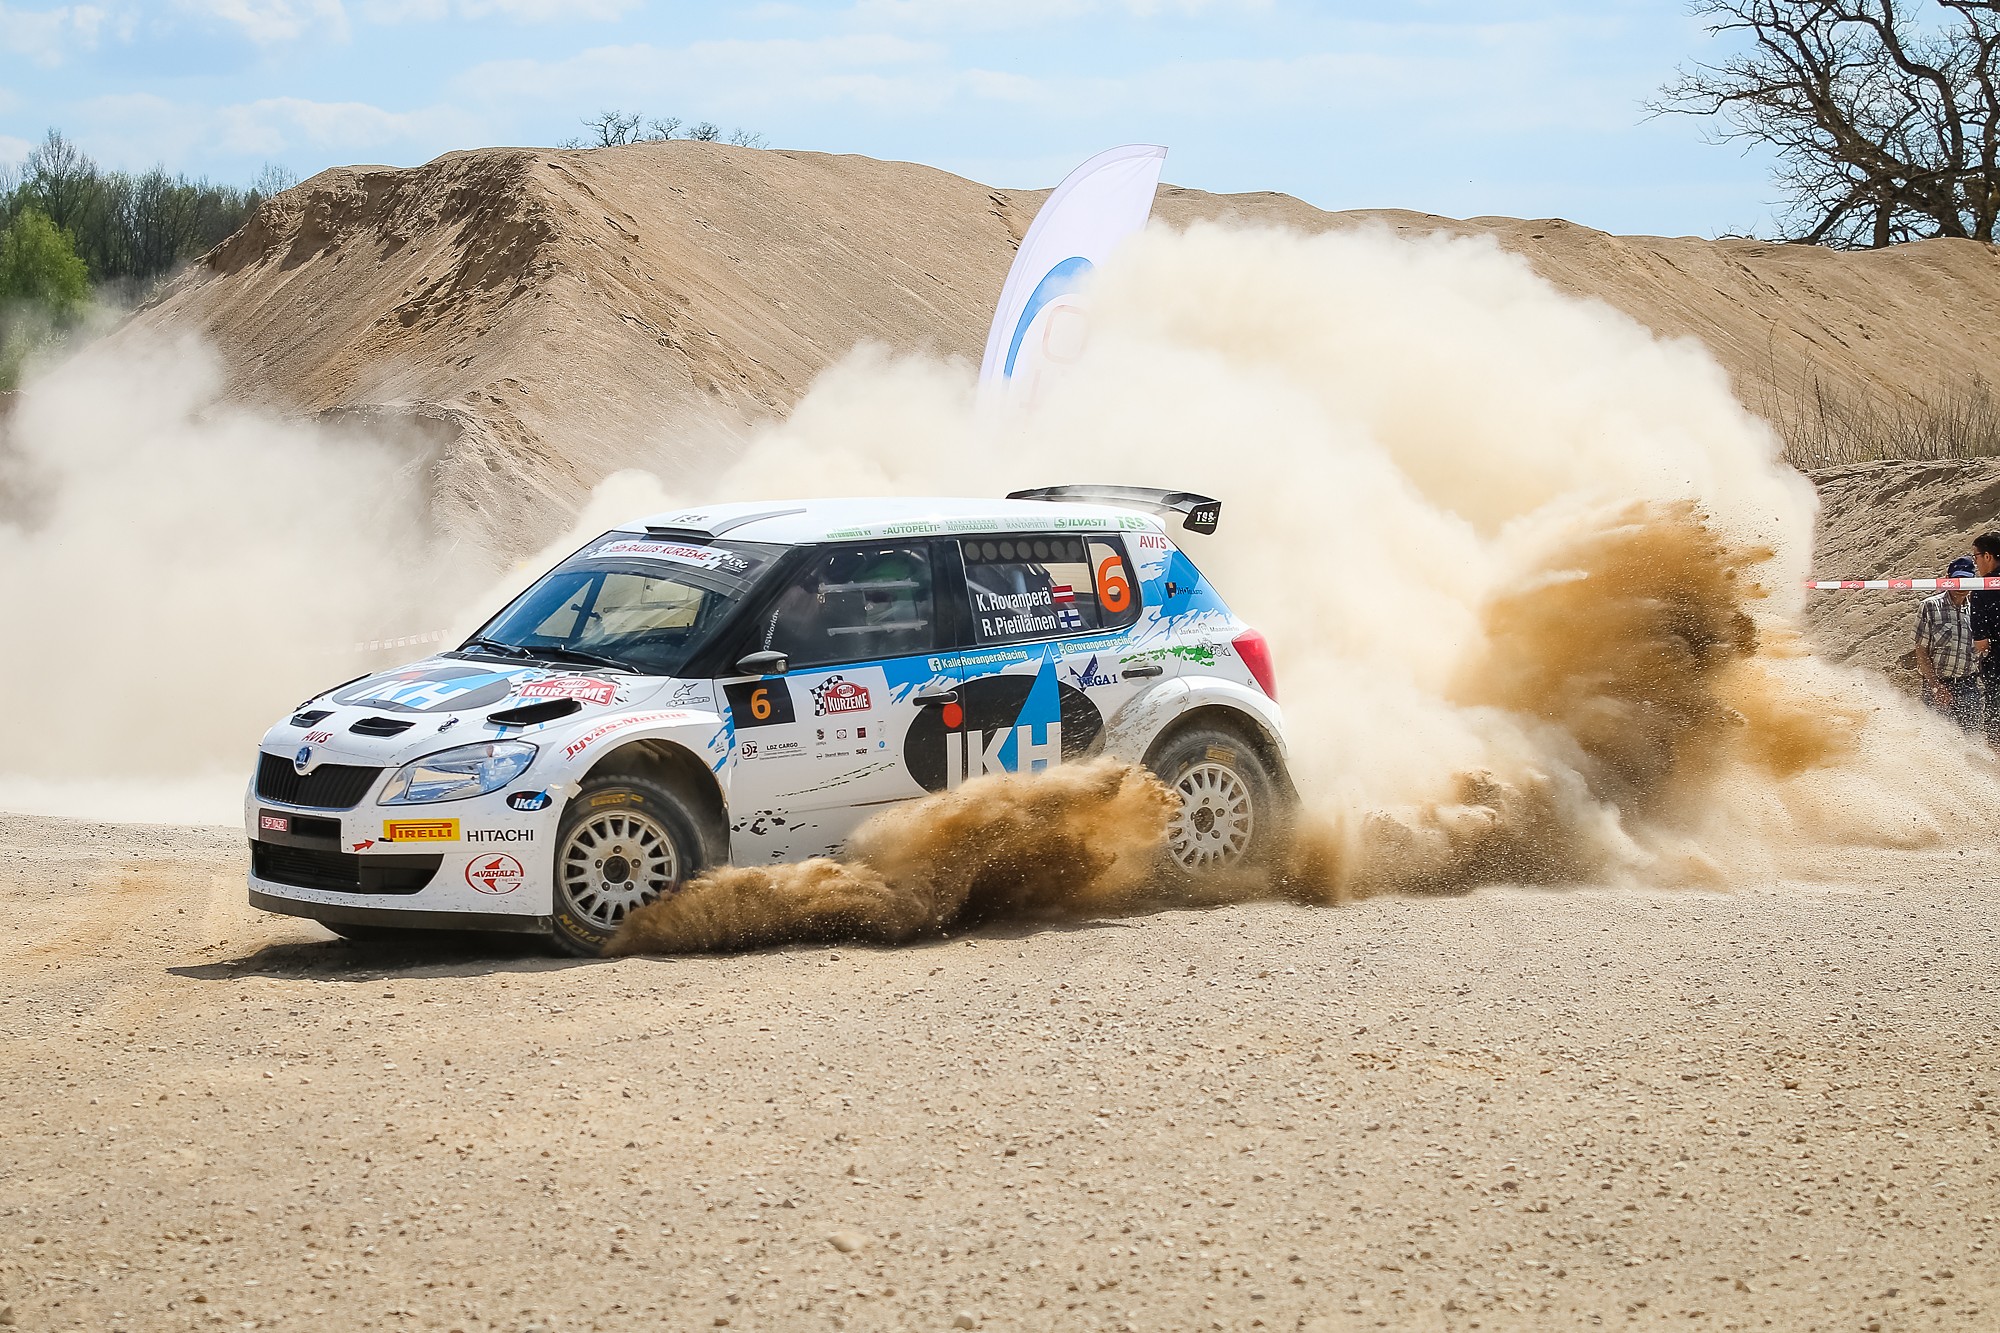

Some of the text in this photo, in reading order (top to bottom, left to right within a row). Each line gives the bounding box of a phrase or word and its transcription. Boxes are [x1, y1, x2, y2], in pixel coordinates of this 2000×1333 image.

[1139, 535, 1167, 550] AVIS
[661, 545, 712, 561] KURZEME
[1097, 555, 1131, 613] 6
[941, 649, 1029, 669] KalleRovanperaRacing
[525, 685, 610, 703] KURZEME
[827, 692, 869, 712] KURZEME
[751, 688, 771, 720] 6
[301, 730, 334, 744] AVIS
[390, 822, 453, 838] PIRELLI
[467, 829, 534, 842] HITACHI
[480, 870, 516, 878] VAHALA
